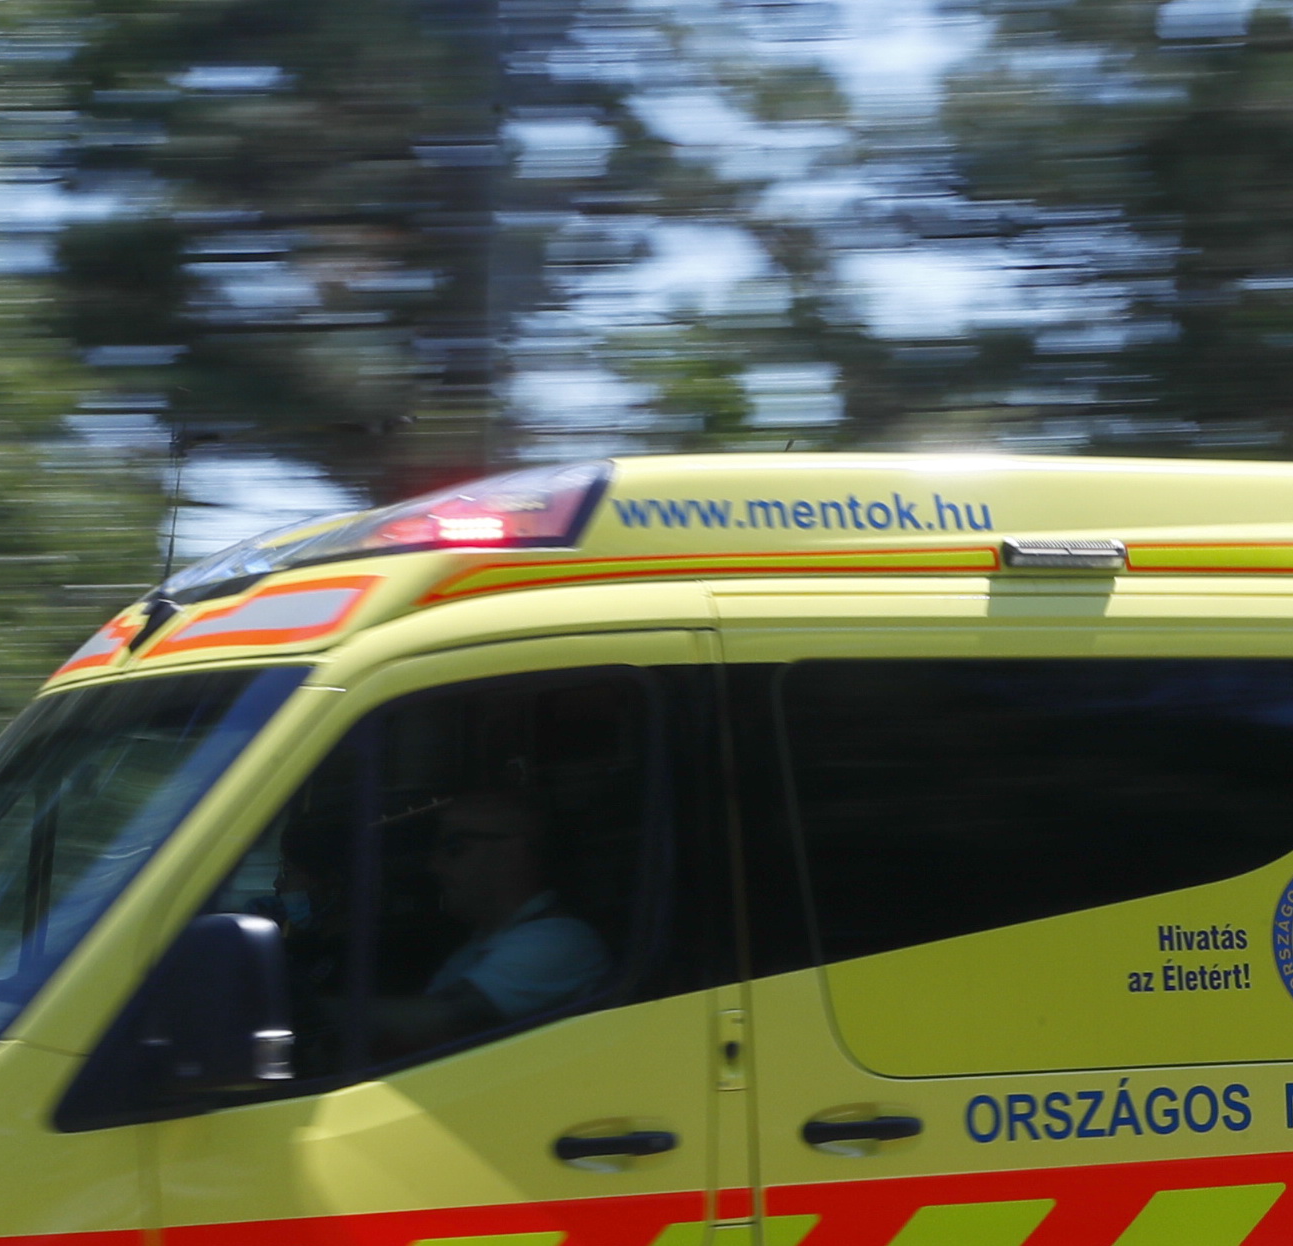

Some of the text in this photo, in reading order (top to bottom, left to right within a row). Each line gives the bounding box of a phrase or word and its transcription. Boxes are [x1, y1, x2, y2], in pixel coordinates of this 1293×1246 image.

[610, 493, 994, 532] www.mentok.hu
[1158, 924, 1248, 951] Hivatás
[1128, 959, 1252, 993] az Életért!
[964, 1078, 1252, 1143] ORSZÁGOS
